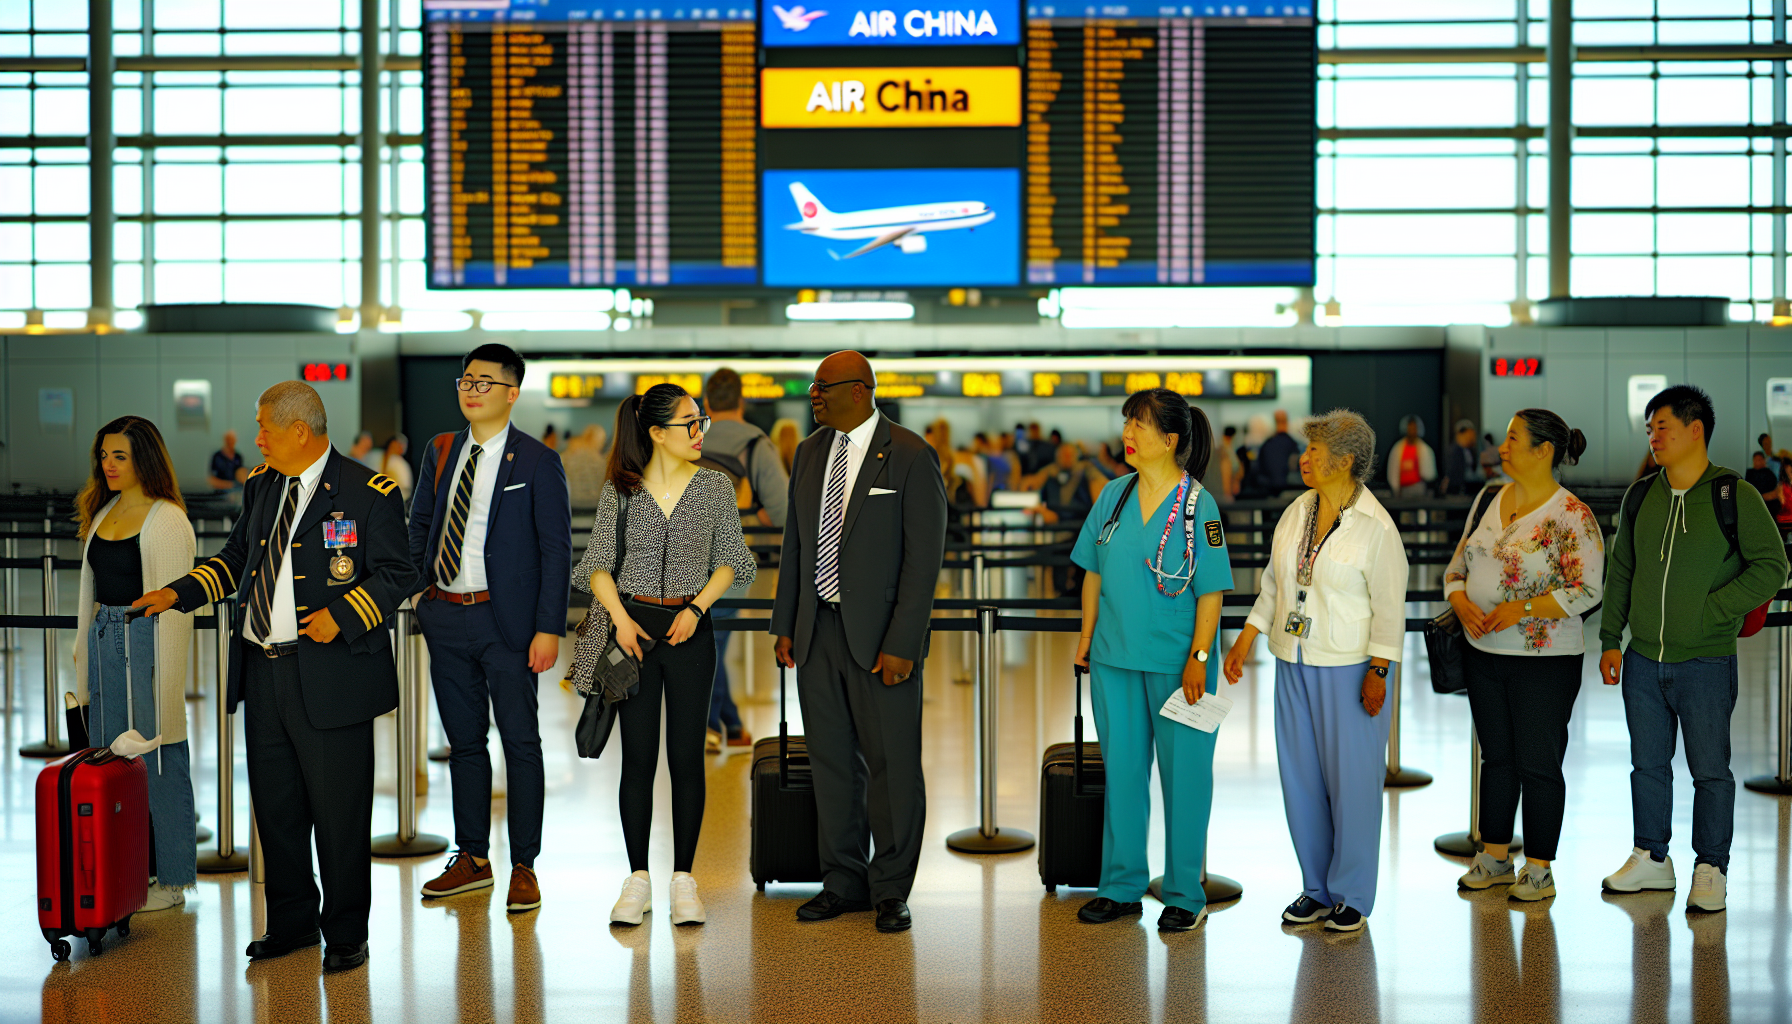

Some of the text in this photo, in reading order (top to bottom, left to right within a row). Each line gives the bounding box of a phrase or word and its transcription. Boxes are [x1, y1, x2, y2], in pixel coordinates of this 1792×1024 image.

[848, 9, 998, 37] AIR CHINA
[806, 79, 969, 112] AIR China
